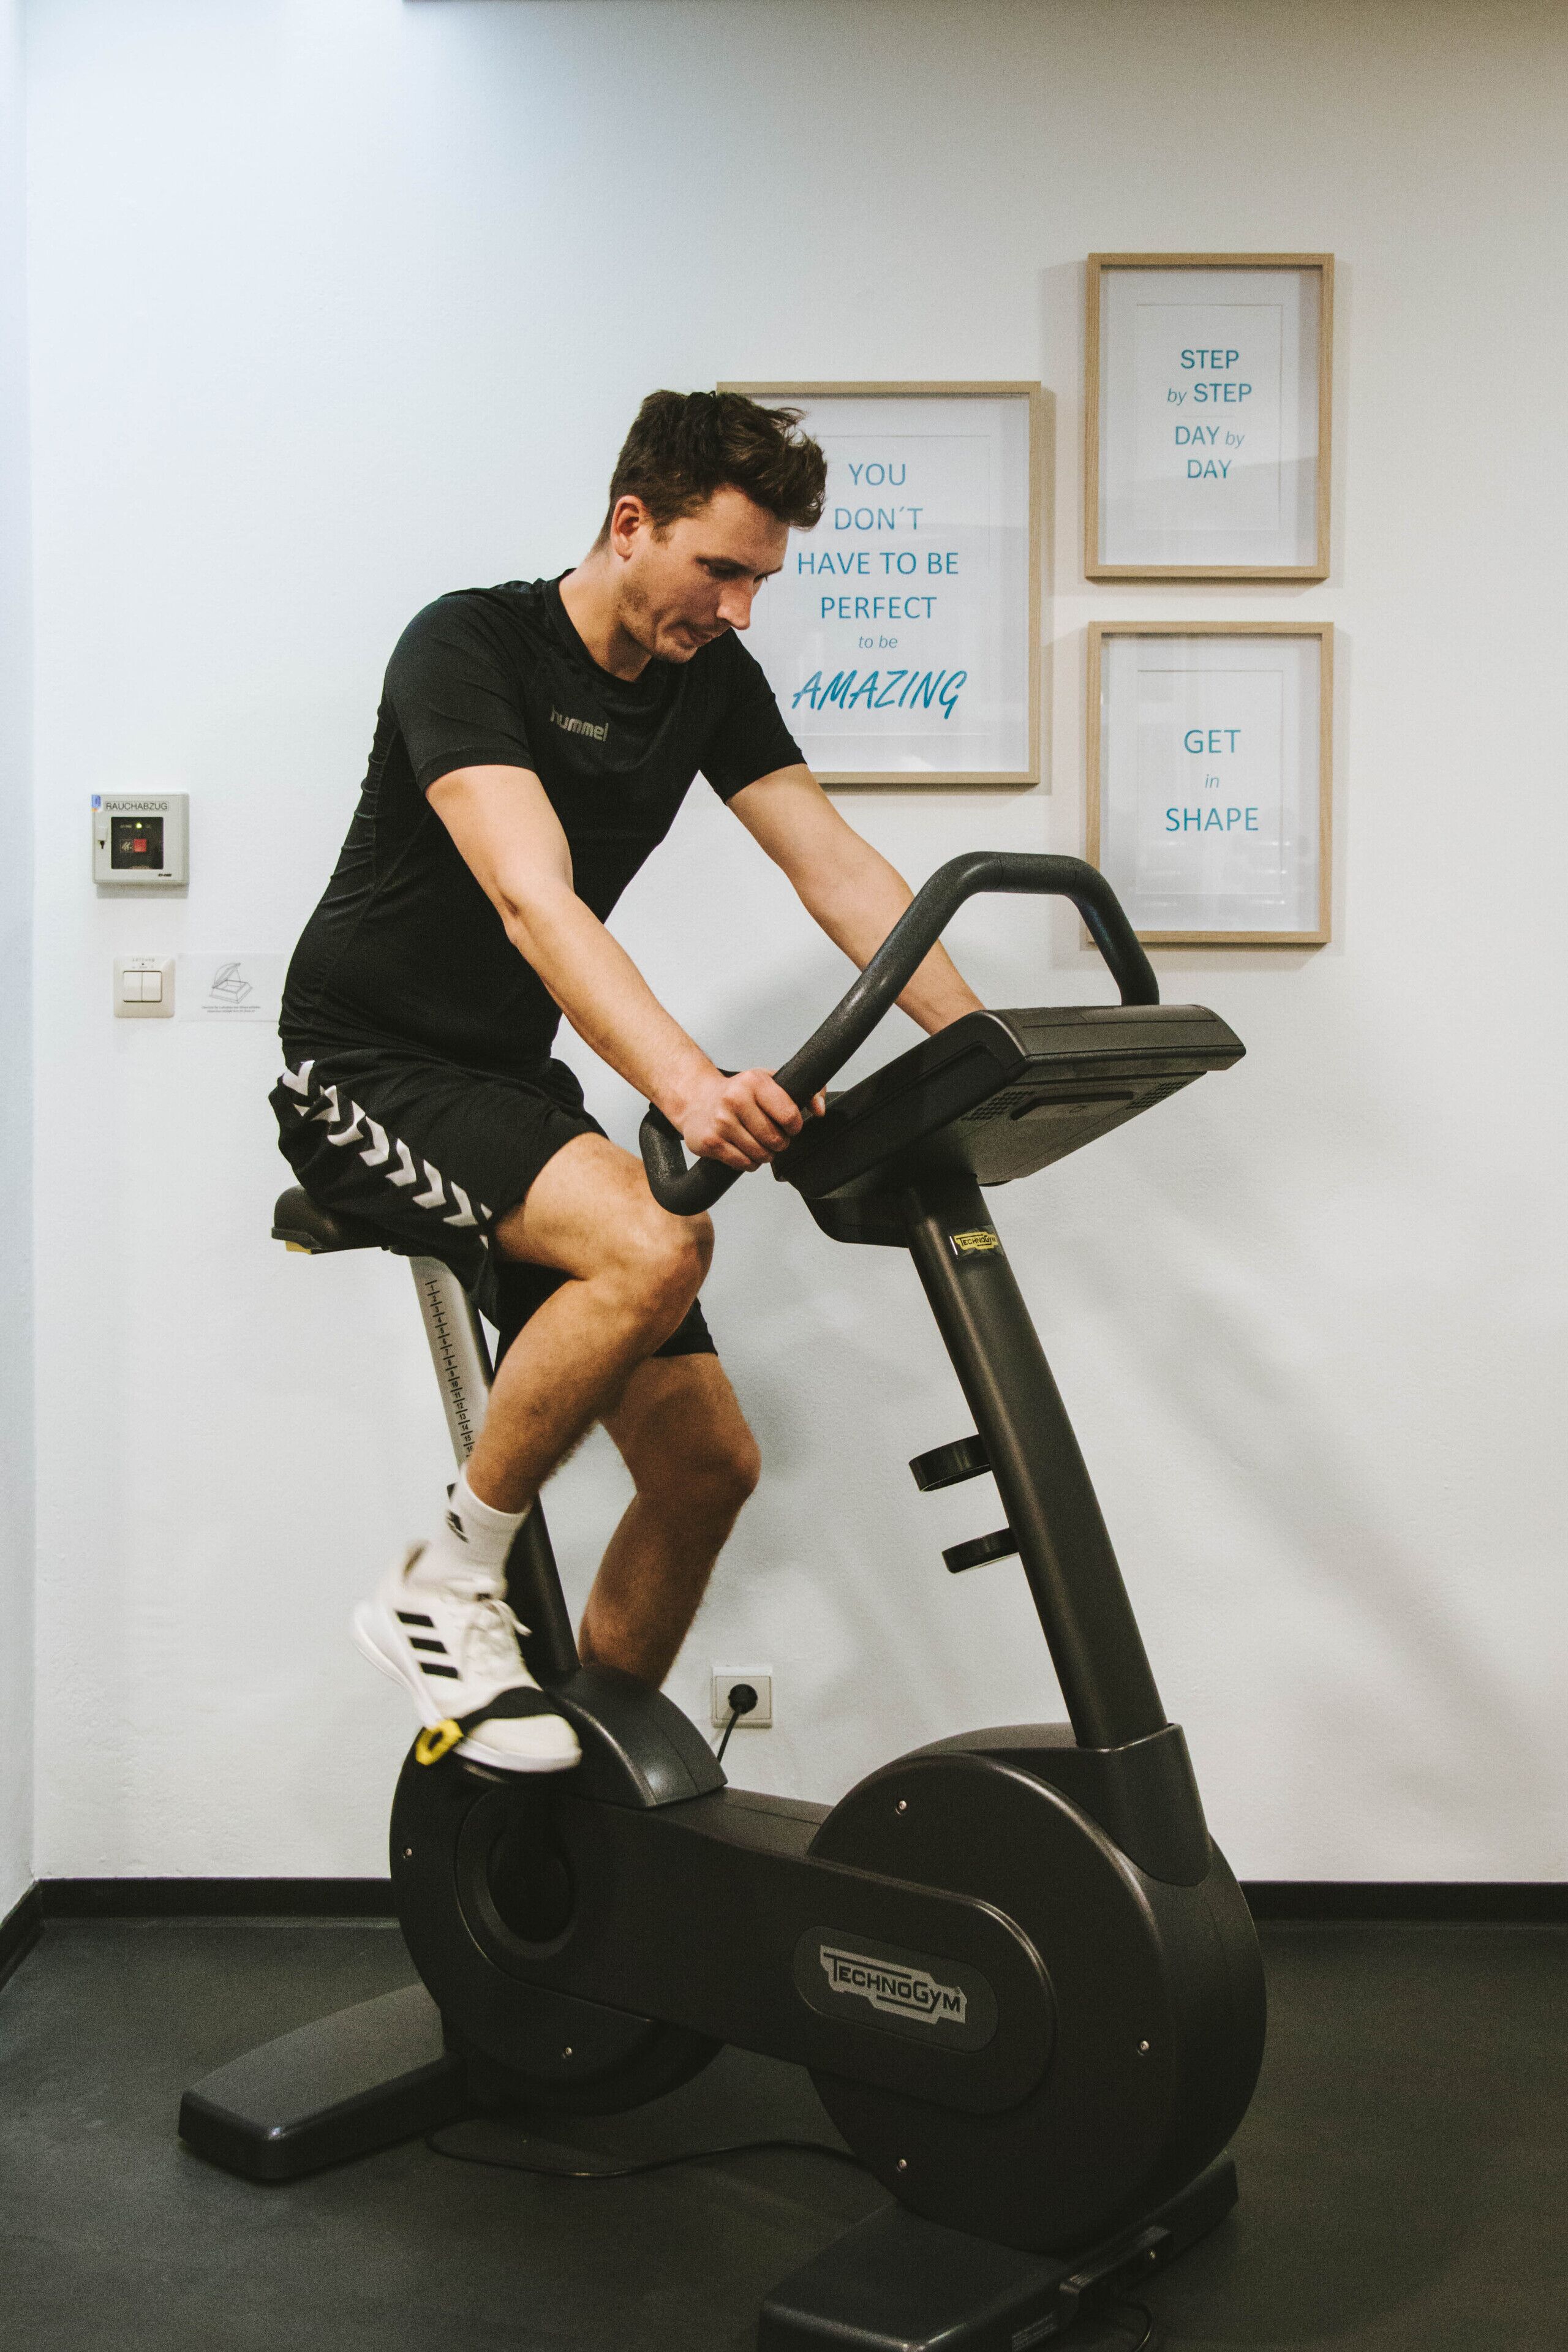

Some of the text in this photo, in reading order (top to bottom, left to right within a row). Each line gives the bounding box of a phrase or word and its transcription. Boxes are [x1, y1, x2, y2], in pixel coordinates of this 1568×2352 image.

[1180, 349, 1240, 369] STEP
[1167, 382, 1253, 406] by STEP
[1175, 425, 1245, 448] DAY by
[848, 463, 907, 486] YOU
[1186, 459, 1232, 479] DAY
[797, 552, 959, 575] HAVE TO BE
[821, 597, 937, 619] PERFECT
[858, 635, 899, 649] to be
[792, 669, 968, 720] AMAZING
[1183, 729, 1241, 754] GET
[1205, 774, 1220, 789] in
[1165, 807, 1259, 832] SHAPE
[823, 1952, 961, 2014] TECHNOGYM
